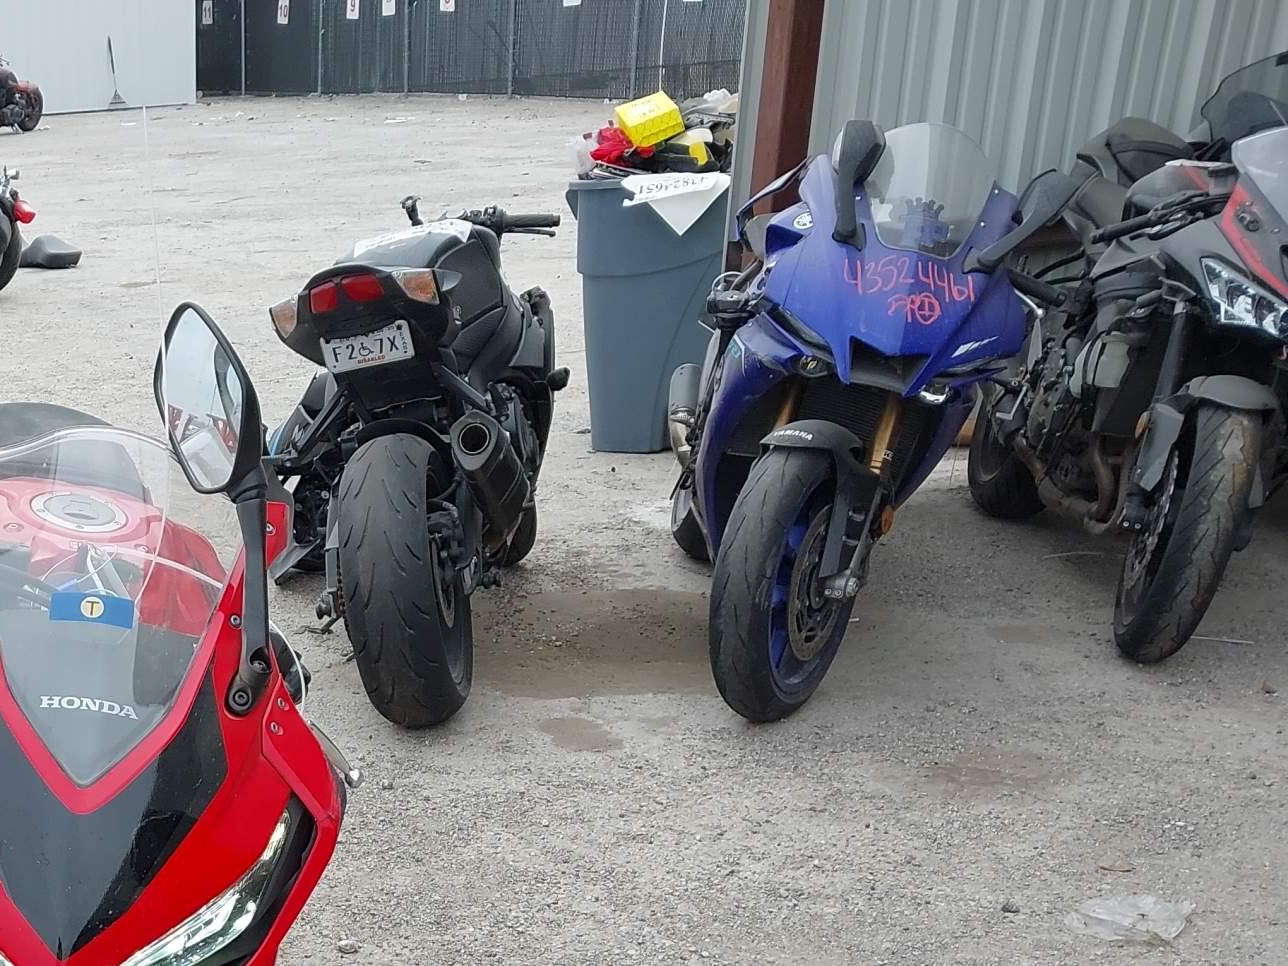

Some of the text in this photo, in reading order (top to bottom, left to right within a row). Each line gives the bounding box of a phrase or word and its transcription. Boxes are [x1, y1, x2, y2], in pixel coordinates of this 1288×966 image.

[203, 6, 212, 19] 11
[279, 4, 288, 18] 10
[773, 429, 813, 441] YAMAHA
[85, 600, 100, 616] T
[39, 695, 139, 720] HONDA
